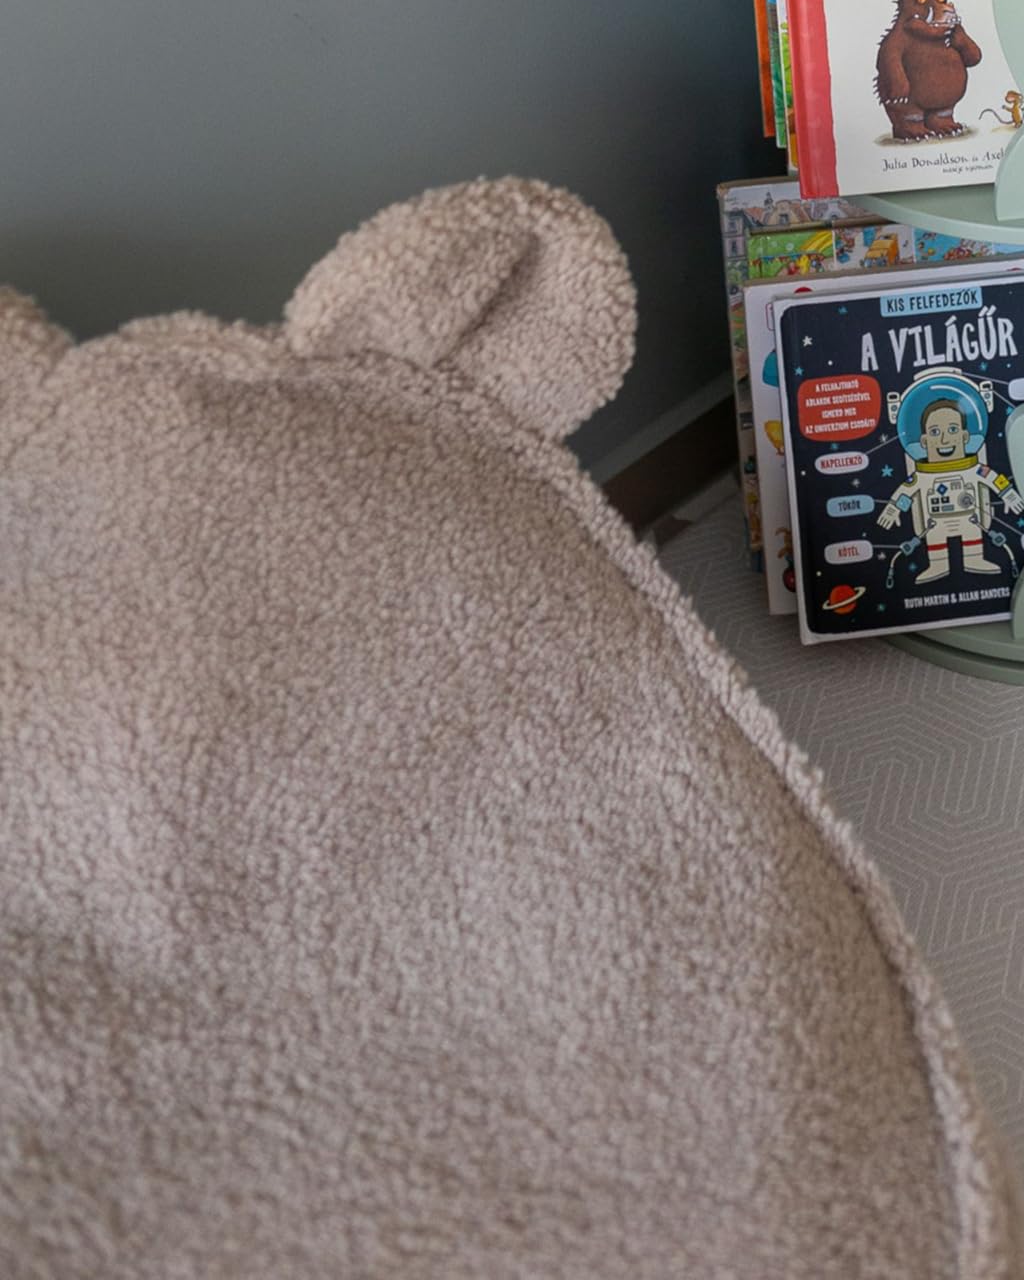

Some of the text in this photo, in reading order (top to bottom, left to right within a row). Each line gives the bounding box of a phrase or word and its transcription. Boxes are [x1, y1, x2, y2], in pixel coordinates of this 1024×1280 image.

[882, 158, 908, 172] Julia
[912, 152, 968, 169] Donaldson
[887, 289, 978, 312] KIS FELFEDEZŐK
[861, 304, 1018, 373] A VILÁGŰR
[815, 384, 820, 392] A
[805, 425, 813, 434] AZ
[904, 587, 1011, 608] RUTH MARTIN & ALLAN SANDERS
